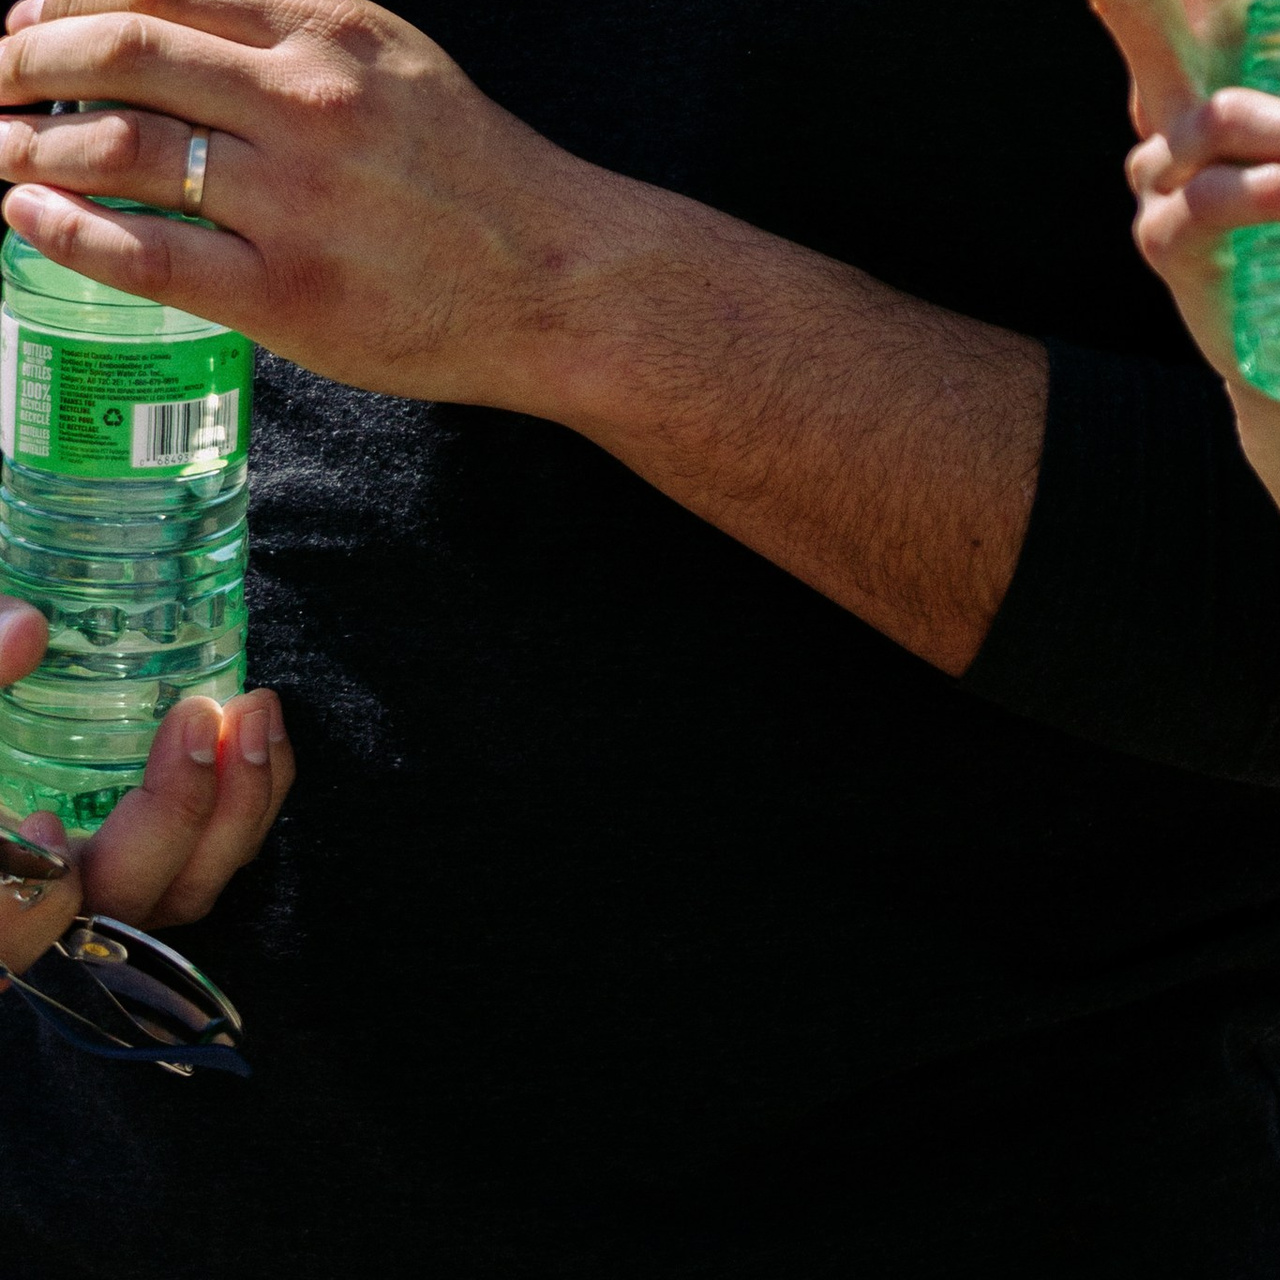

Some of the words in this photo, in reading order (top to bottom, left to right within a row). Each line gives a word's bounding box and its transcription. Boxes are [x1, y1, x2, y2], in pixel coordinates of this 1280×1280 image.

[23, 341, 53, 360] BOTTLES
[61, 348, 82, 358] Product
[22, 361, 52, 381] BOTTLES
[21, 379, 52, 401] 100%
[21, 397, 52, 413] RECYCLED
[157, 454, 190, 466] 68493
